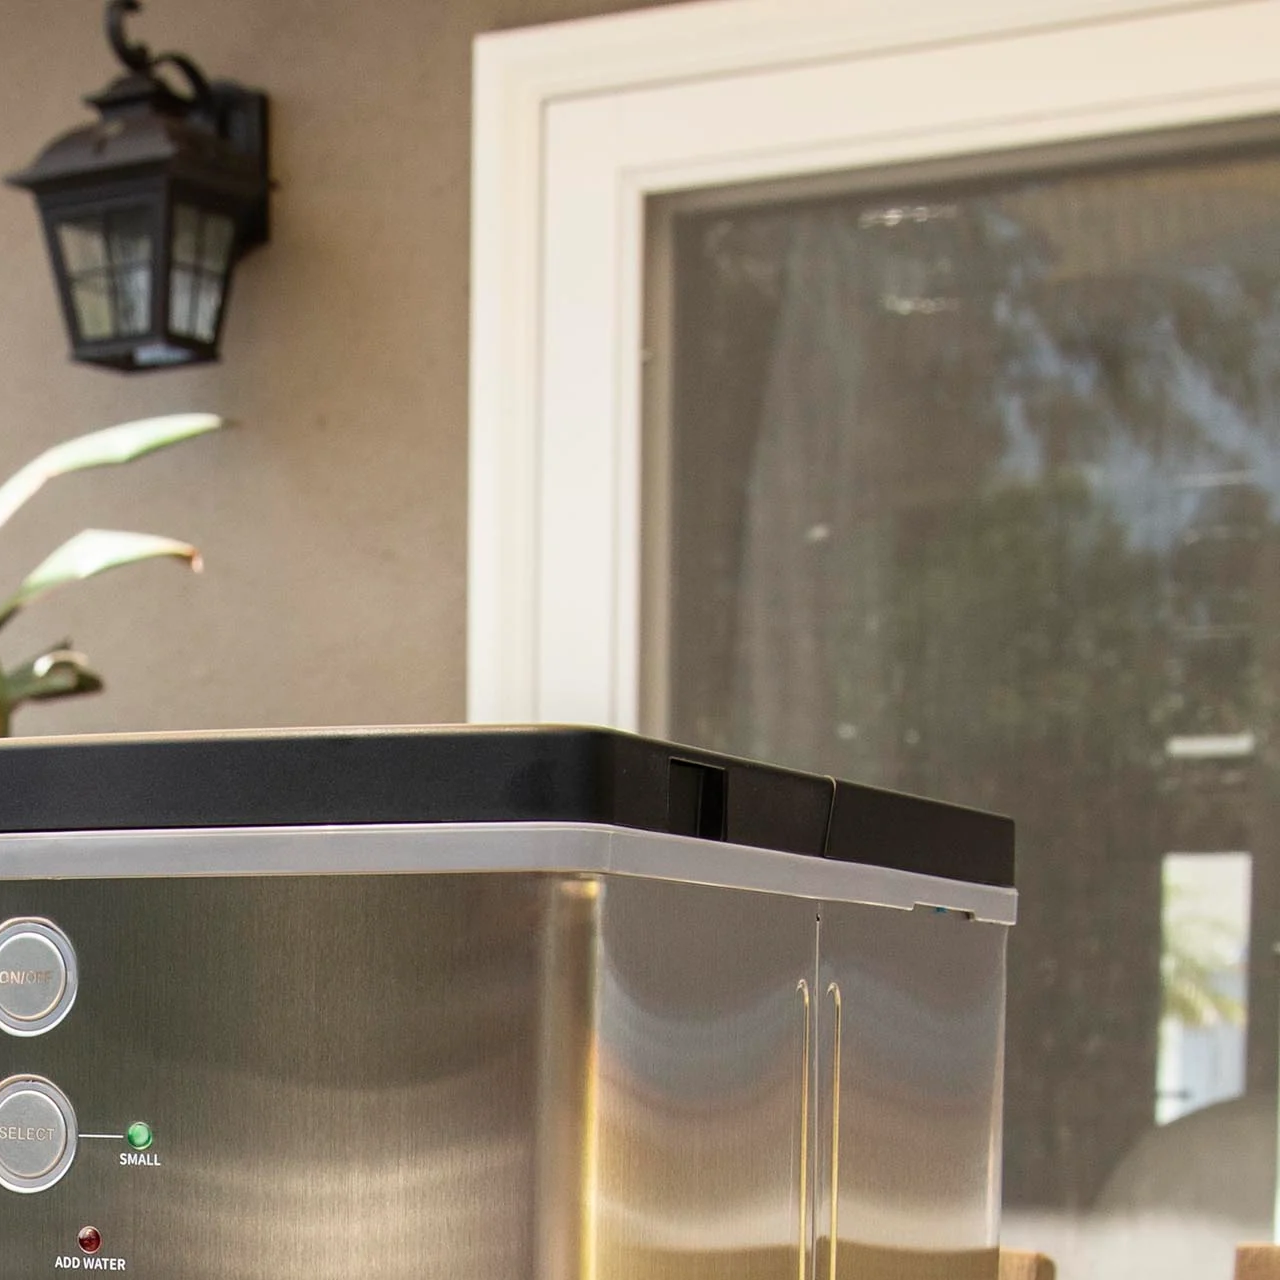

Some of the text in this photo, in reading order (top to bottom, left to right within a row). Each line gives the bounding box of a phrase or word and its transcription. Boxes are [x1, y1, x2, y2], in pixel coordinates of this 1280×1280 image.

[119, 1153, 161, 1167] SMALL
[55, 1256, 126, 1271] ADD WATER
